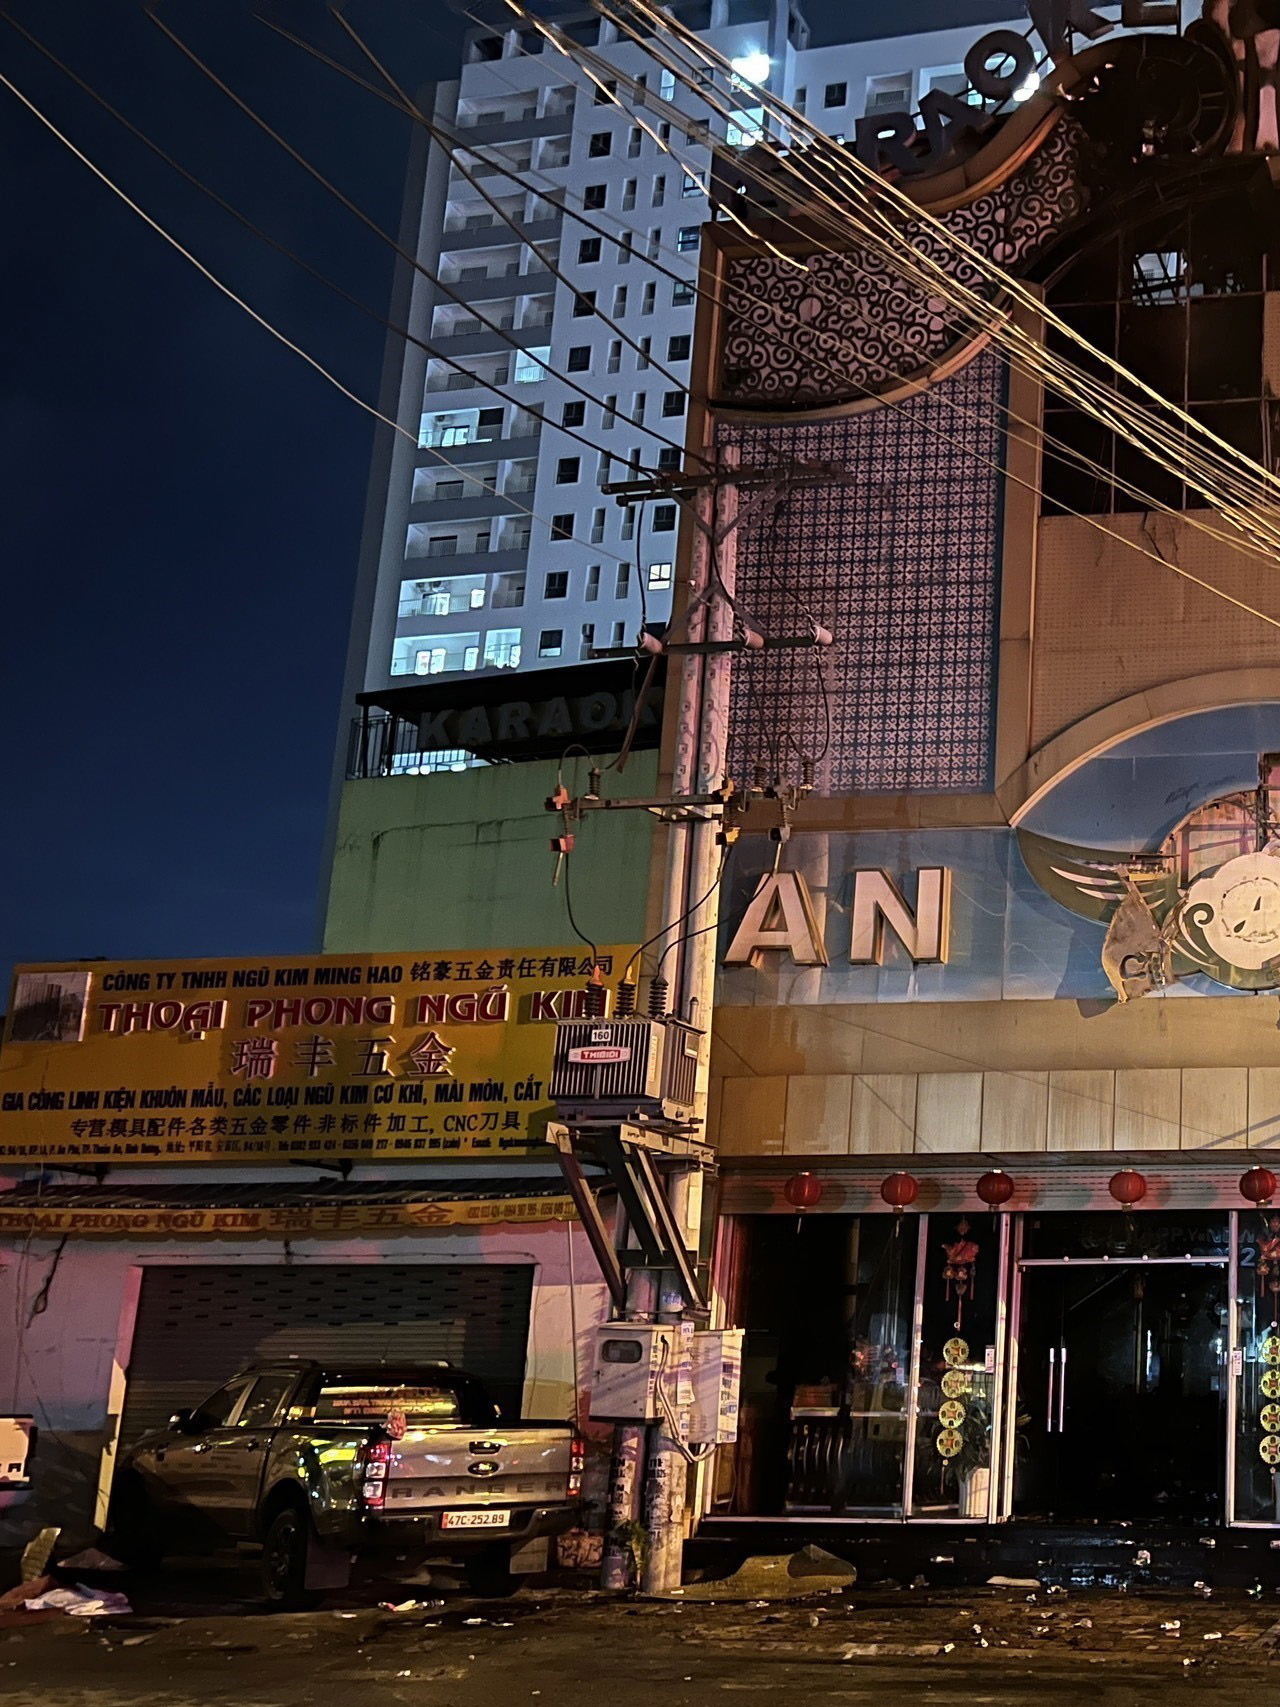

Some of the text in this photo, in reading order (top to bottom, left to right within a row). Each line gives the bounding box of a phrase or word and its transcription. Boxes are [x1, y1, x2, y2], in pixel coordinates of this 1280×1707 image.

[721, 865, 951, 967] AN
[103, 965, 403, 991] CÔNG TY TNHH NGŨ KIM MING HAO
[99, 999, 228, 1041] THOẠI
[246, 995, 395, 1031] PHONG
[416, 984, 511, 1024] NGŨ
[592, 1031, 610, 1041] 160
[230, 1030, 457, 1080] 瑞丰五金
[233, 1083, 262, 1107] CÁC
[267, 1085, 299, 1109] LOẠI
[339, 1084, 369, 1105] KIM
[434, 1079, 464, 1103] MÀI
[68, 1212, 150, 1228] PHONG
[212, 1212, 263, 1228] KIM
[391, 1481, 563, 1499] RANGER
